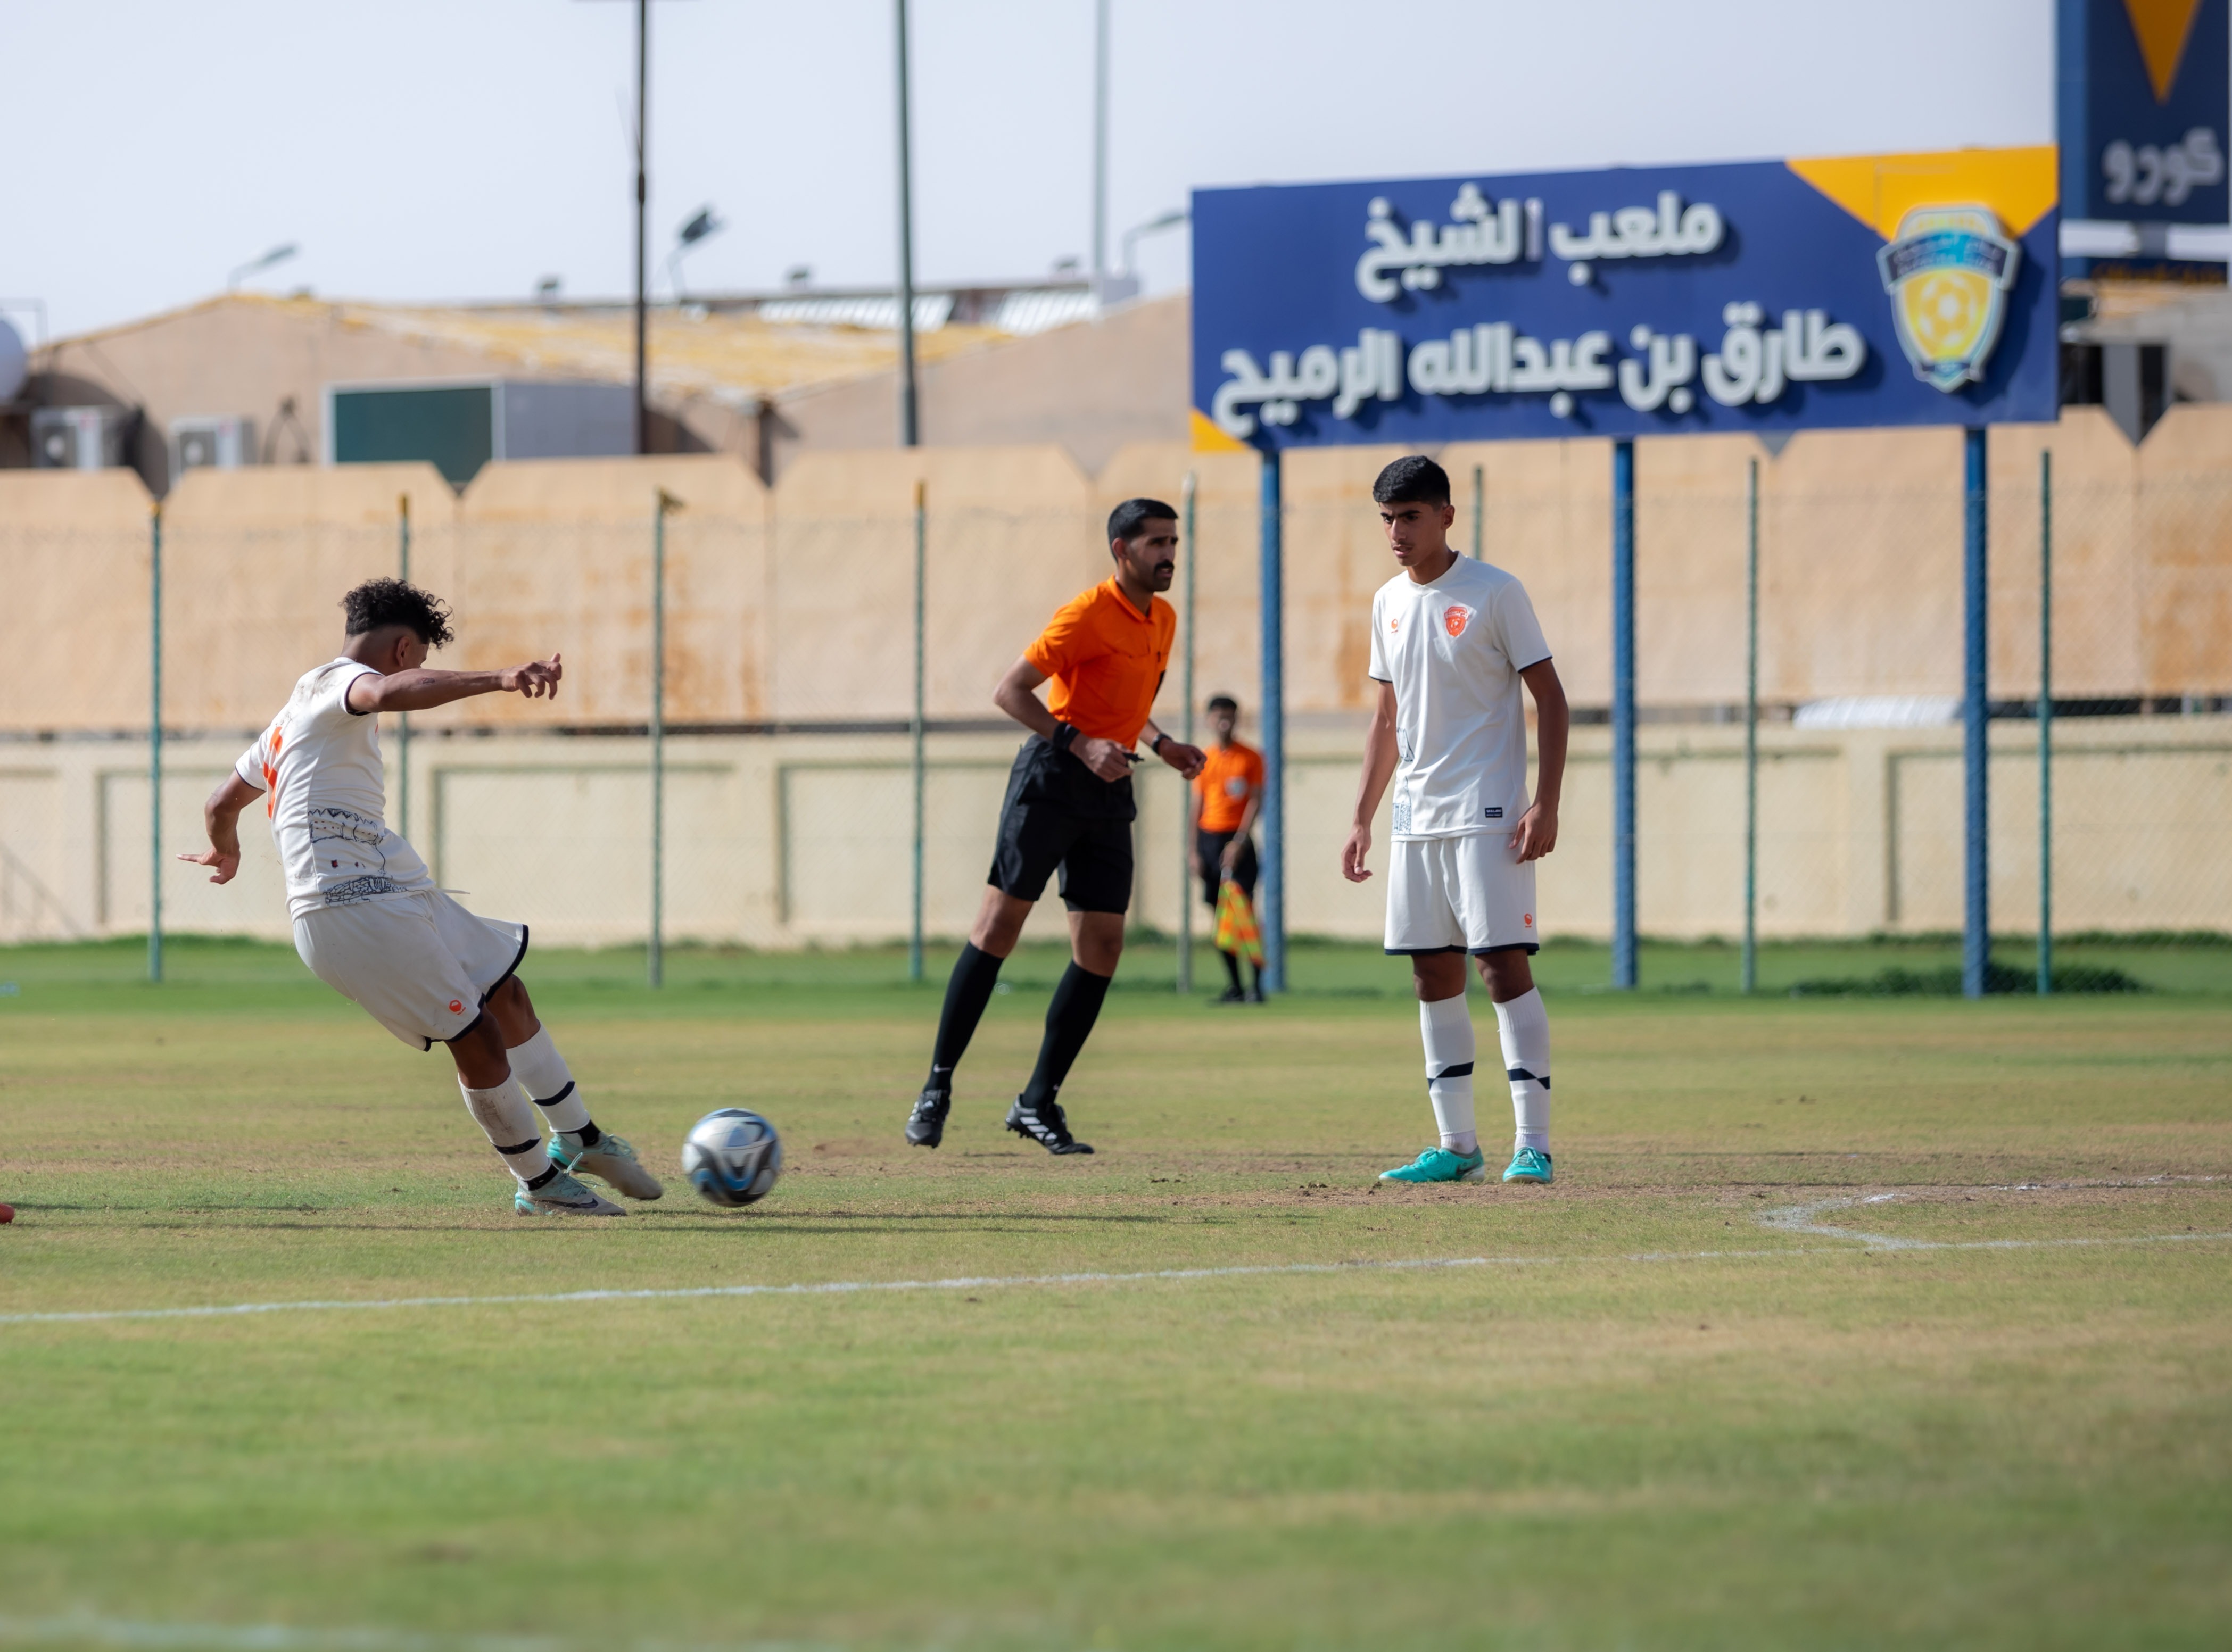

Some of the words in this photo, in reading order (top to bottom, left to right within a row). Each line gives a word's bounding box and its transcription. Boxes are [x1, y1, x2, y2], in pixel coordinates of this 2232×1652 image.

[1355, 182, 1543, 303] الشيخ
[1548, 189, 1722, 286] ملعب
[1210, 326, 1403, 440] الرميح
[1407, 321, 1613, 418] عبدالله
[1619, 324, 1694, 412] بن
[1702, 301, 1864, 406] طارق
